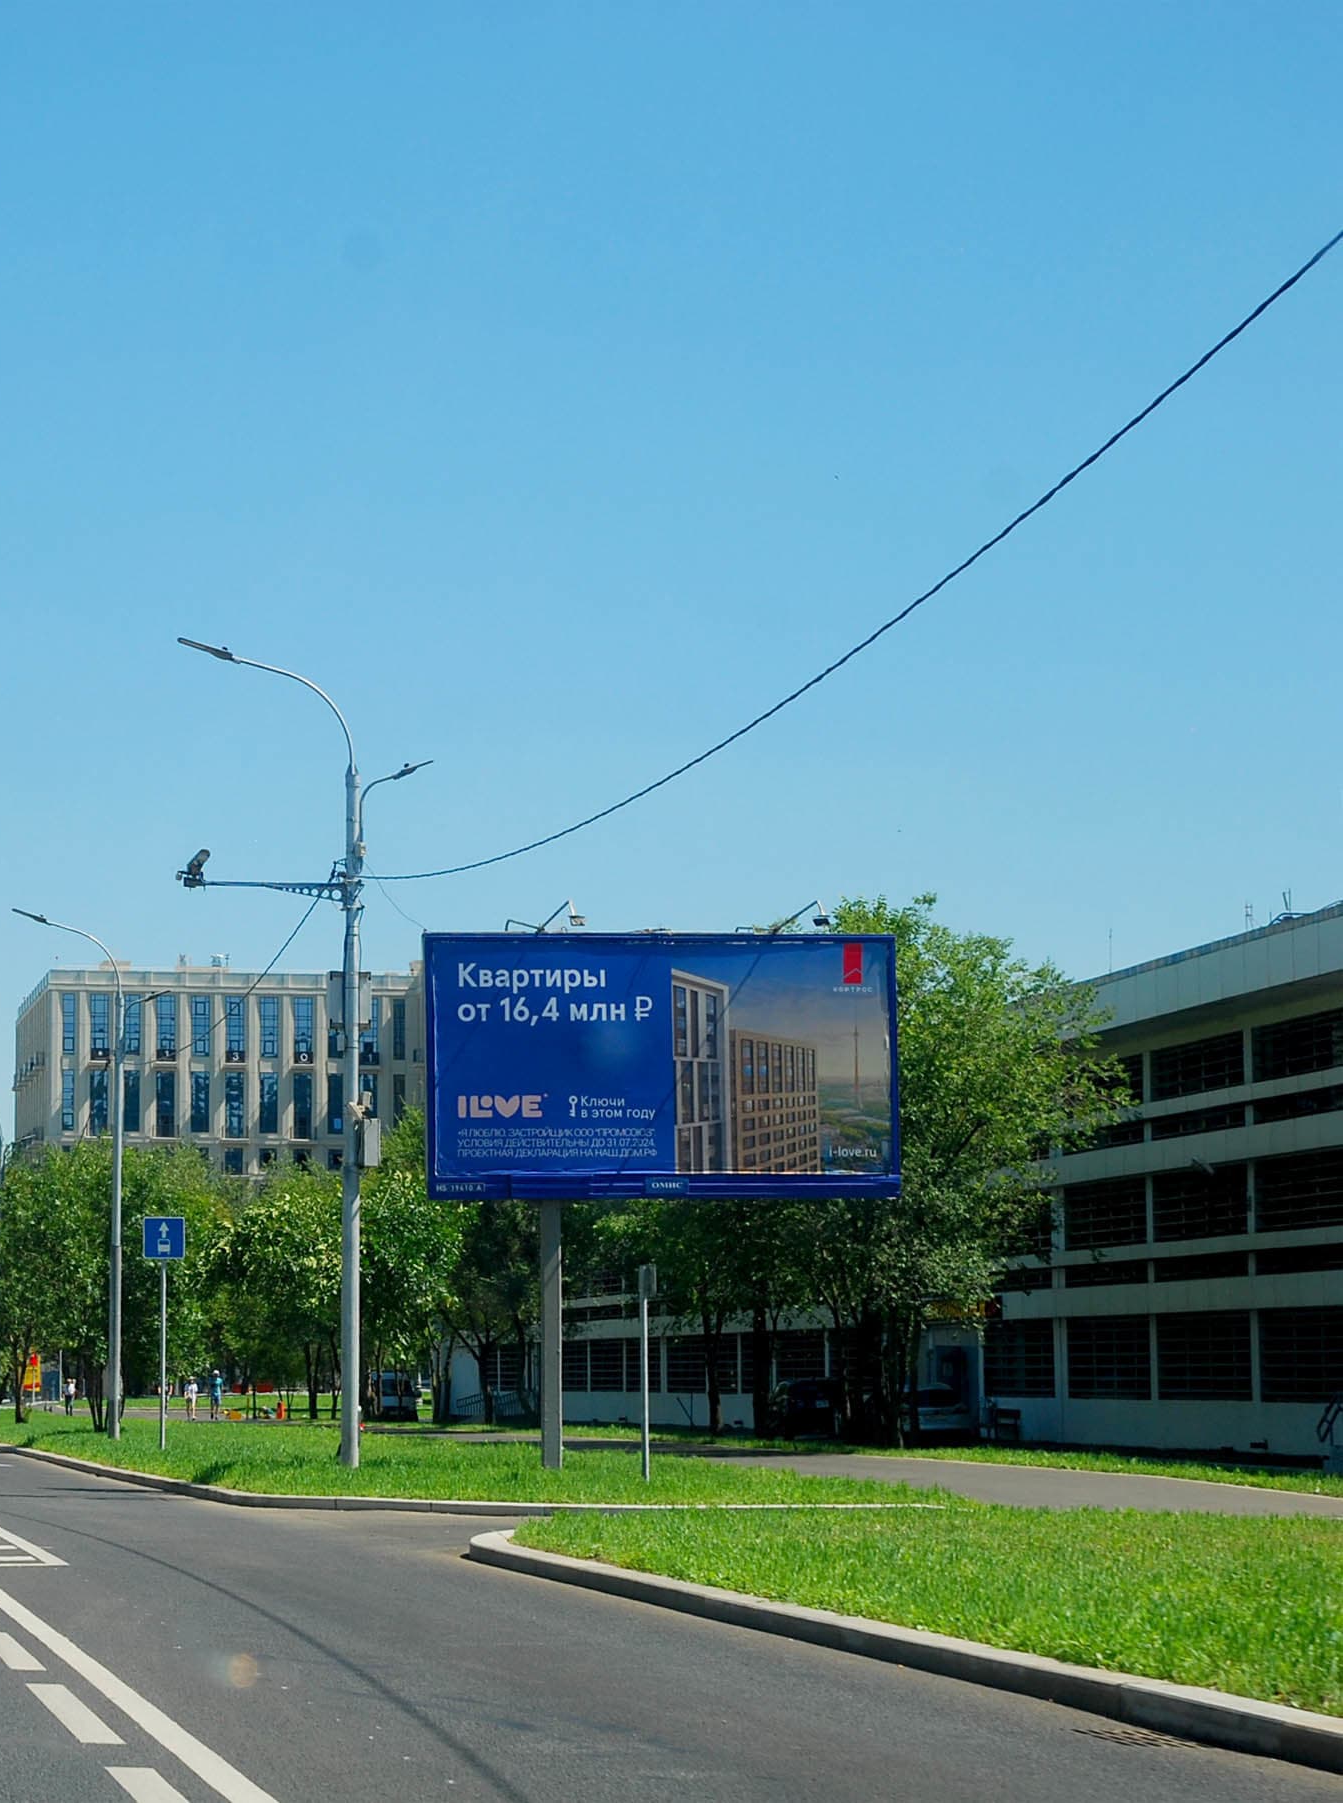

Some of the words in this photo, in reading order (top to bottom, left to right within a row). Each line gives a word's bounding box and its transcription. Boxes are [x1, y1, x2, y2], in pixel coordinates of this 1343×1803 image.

[457, 962, 606, 994] Квартиры
[457, 1003, 491, 1022] от
[500, 997, 560, 1027] 16,4
[569, 1003, 626, 1022] млн
[634, 996, 653, 1022] ₽
[580, 1096, 625, 1107] Ключи
[581, 1109, 589, 1118] в
[591, 1109, 623, 1118] этом
[626, 1109, 656, 1121] году
[508, 1126, 574, 1139] ЗАСТРОЙЩИК
[574, 1128, 595, 1137] ООО
[457, 1138, 503, 1148] УСЛОВИЯ
[505, 1137, 589, 1149] ДЕЙСТВИТЕЛЬНЫ
[591, 1138, 606, 1148] ДО
[457, 1149, 513, 1158] ПРОЕКТНАЯ
[515, 1149, 578, 1160] ДЕКЛАРАЦИЯ
[580, 1149, 593, 1158] НА
[828, 1145, 877, 1158] i-love.ru
